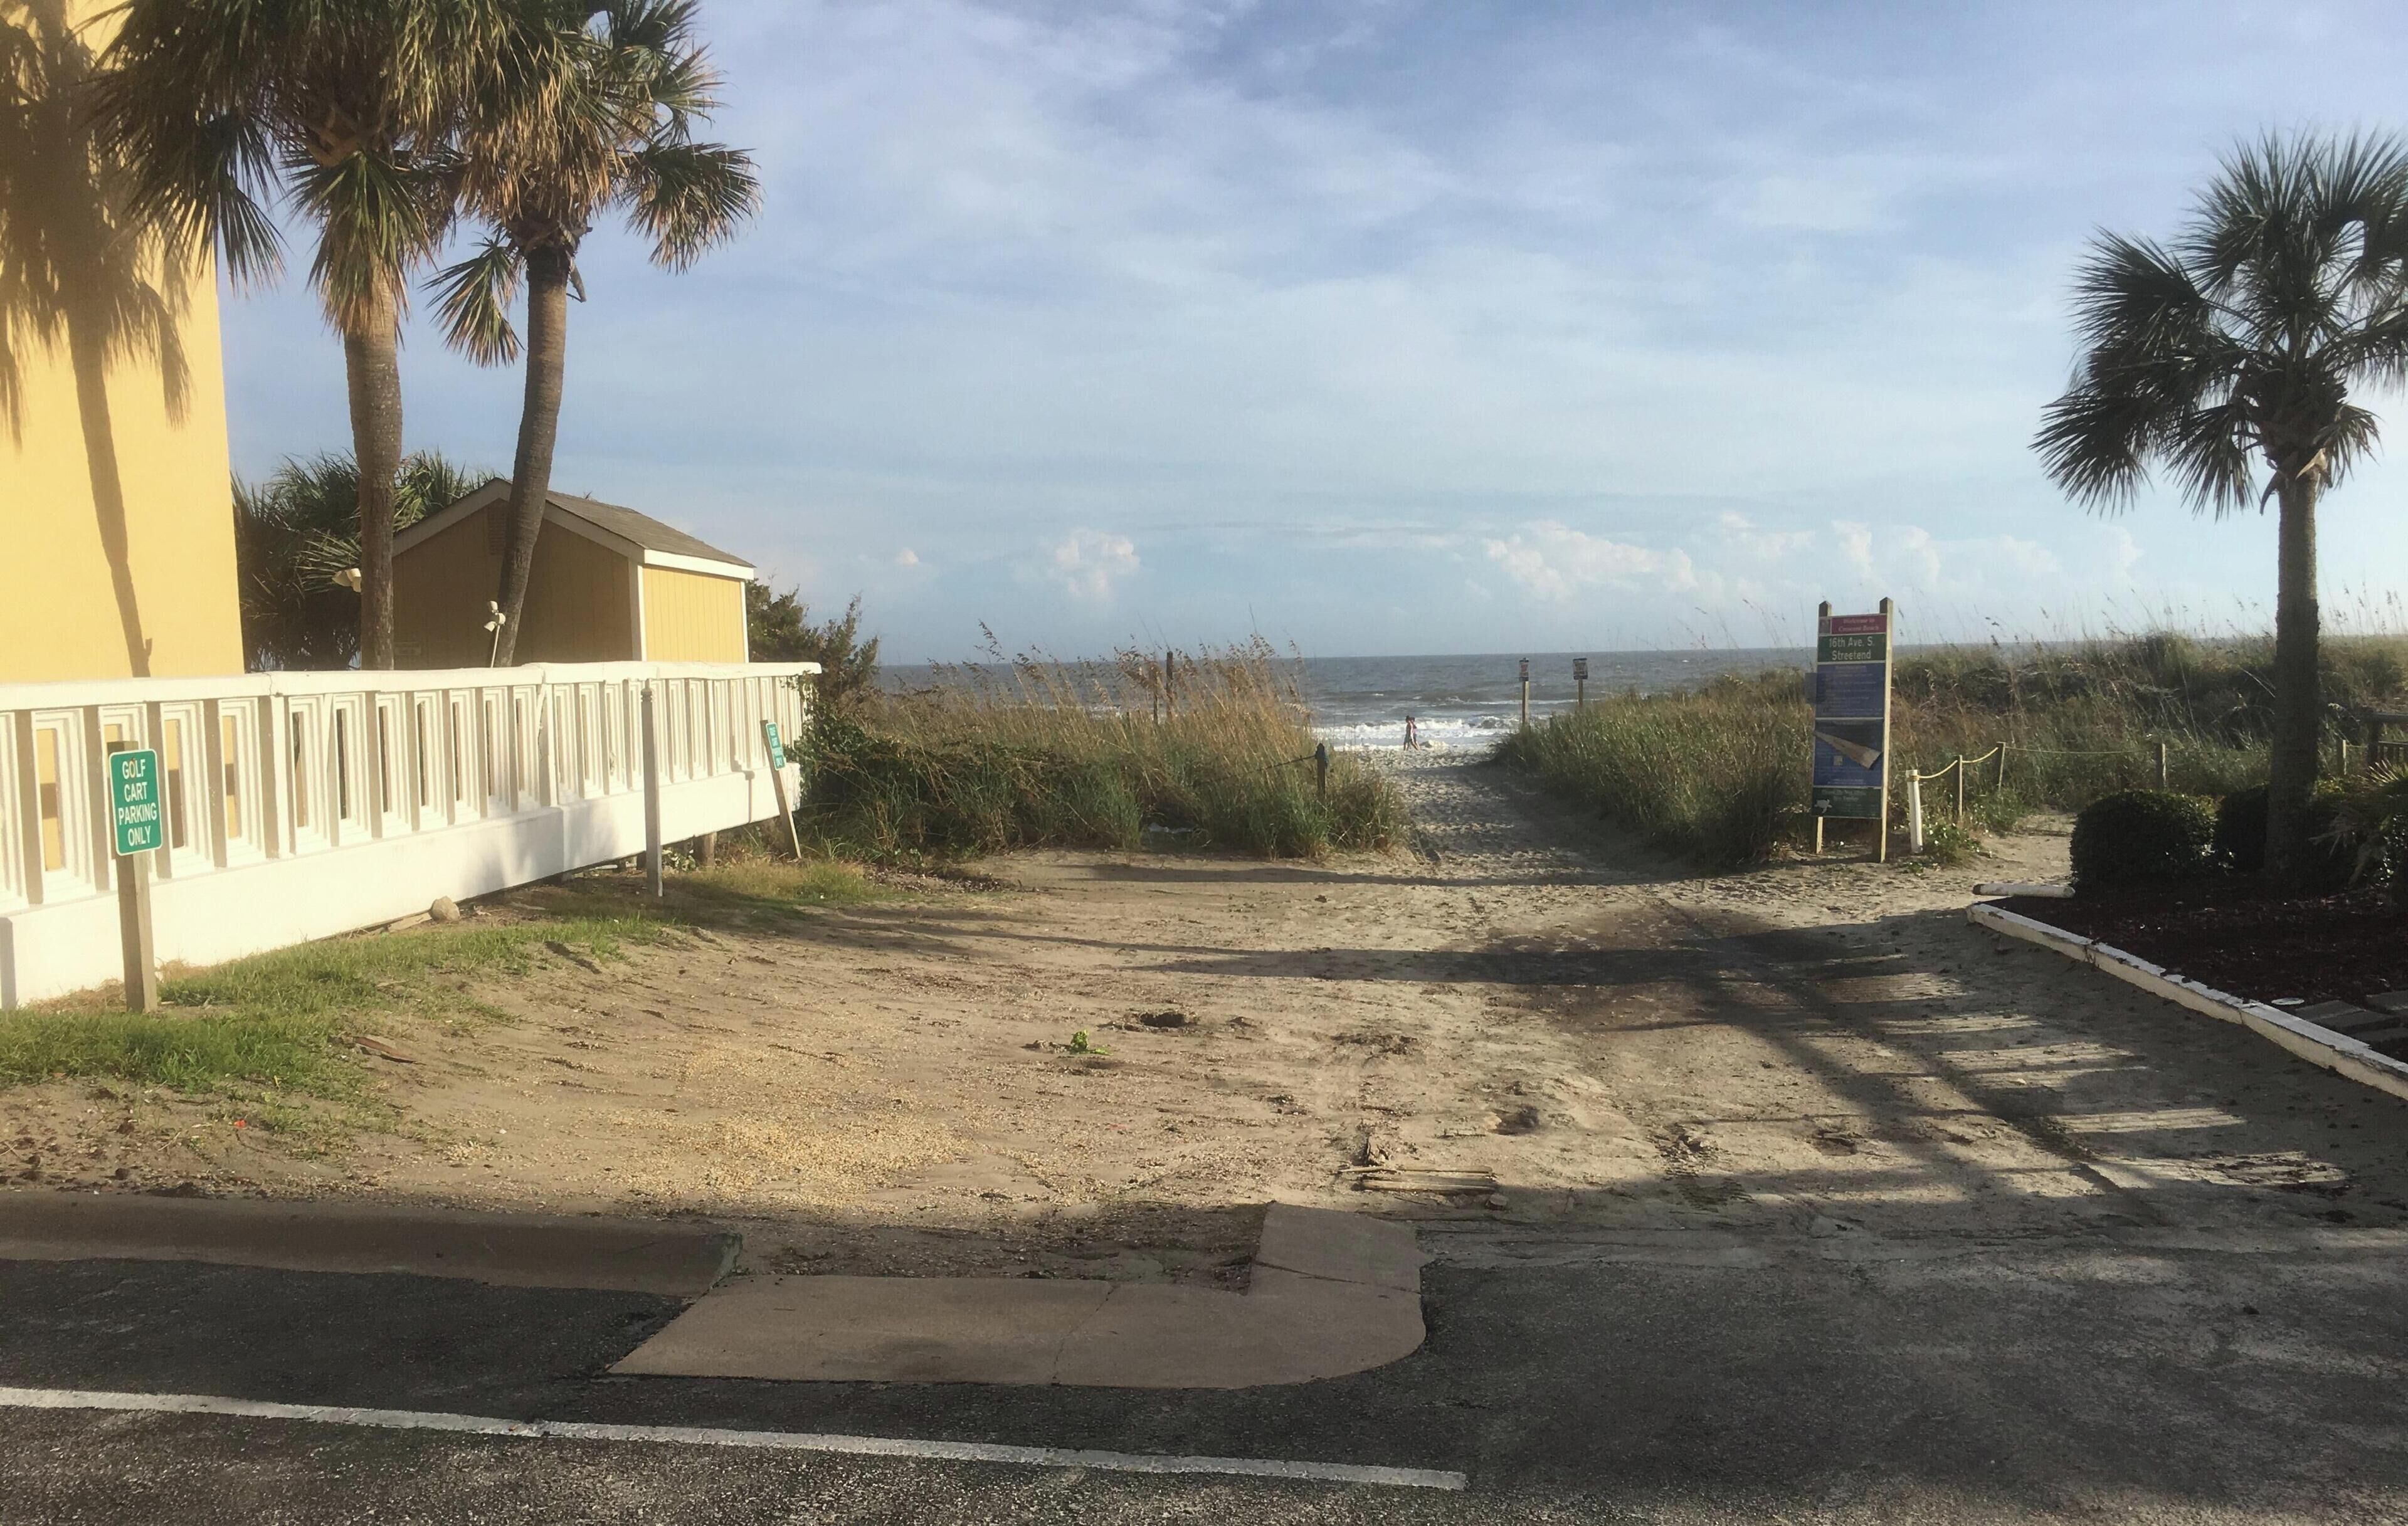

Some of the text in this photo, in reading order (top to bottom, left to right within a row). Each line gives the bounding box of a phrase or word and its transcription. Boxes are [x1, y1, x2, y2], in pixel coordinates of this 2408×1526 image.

[1829, 636, 1875, 648] 16th Ave. S.
[1831, 649, 1872, 661] Streetend
[122, 759, 145, 779] GOLF
[124, 781, 147, 802] CART
[118, 802, 157, 825] PARKING
[128, 826, 151, 846] ONLY
